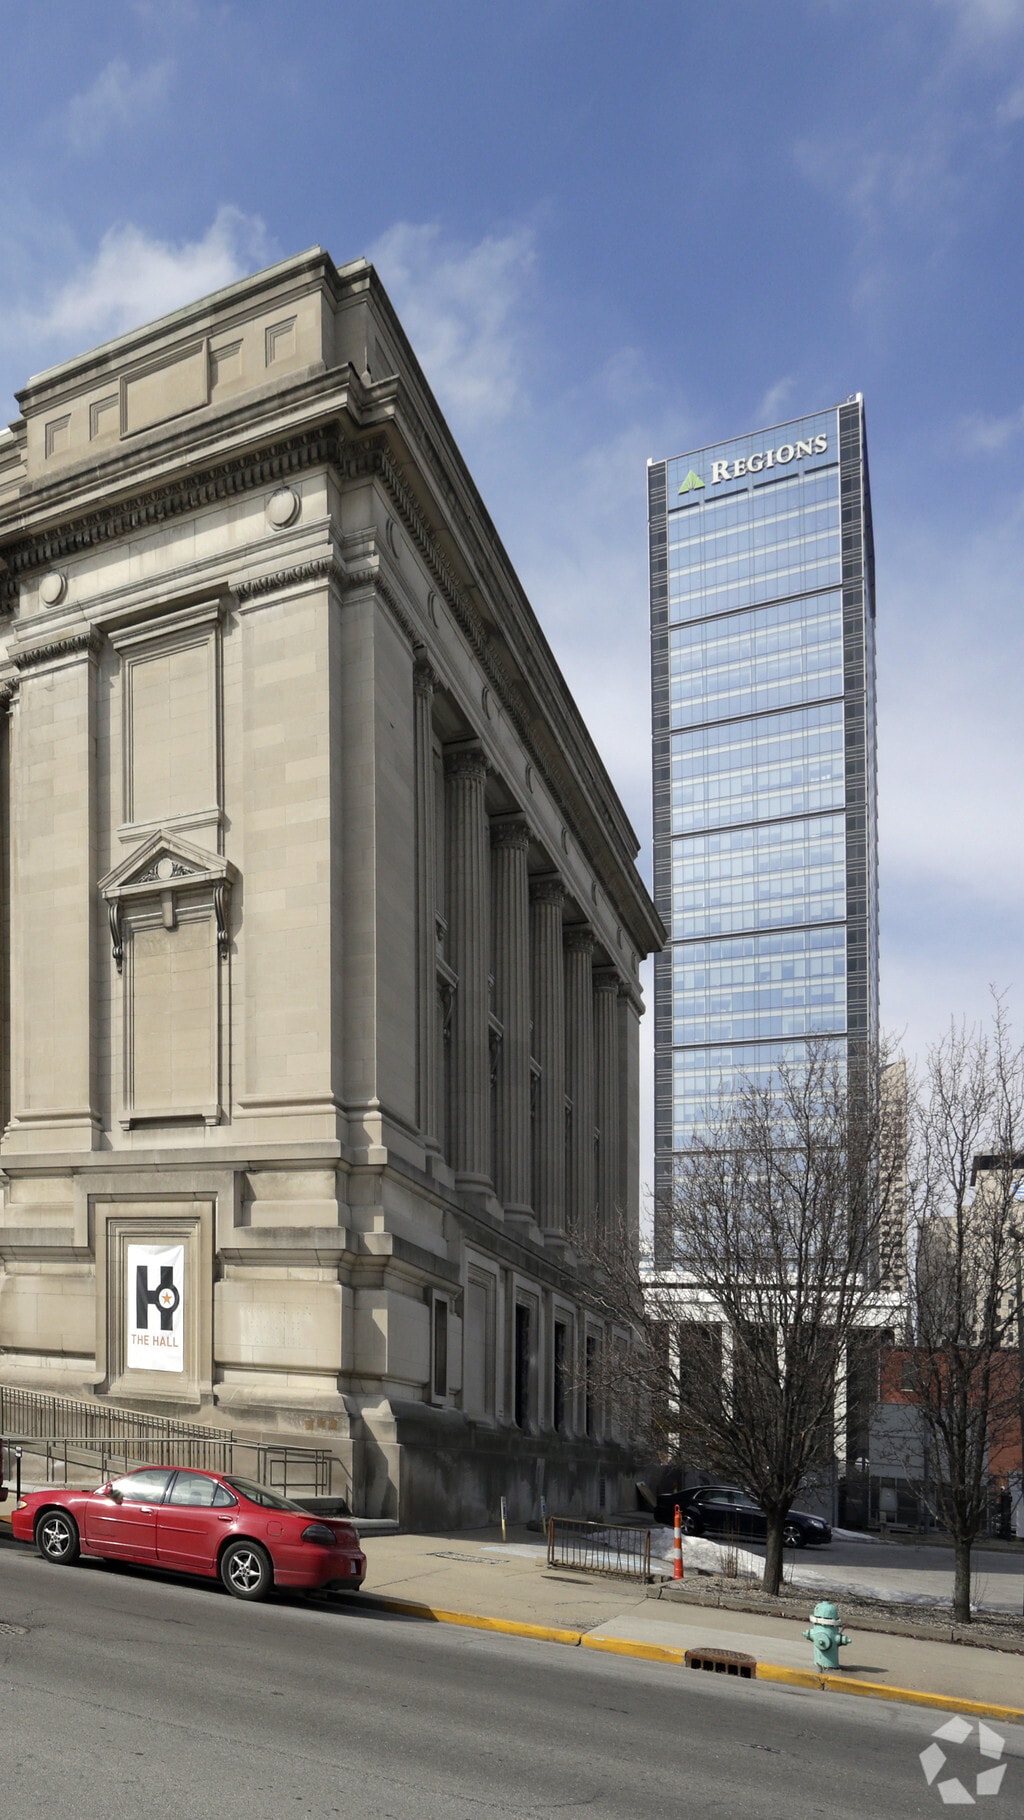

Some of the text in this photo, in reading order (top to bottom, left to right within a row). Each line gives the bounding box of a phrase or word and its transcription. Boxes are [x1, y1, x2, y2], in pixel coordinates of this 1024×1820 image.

[711, 433, 828, 485] REGIONS
[131, 1334, 179, 1347] THE HALL
